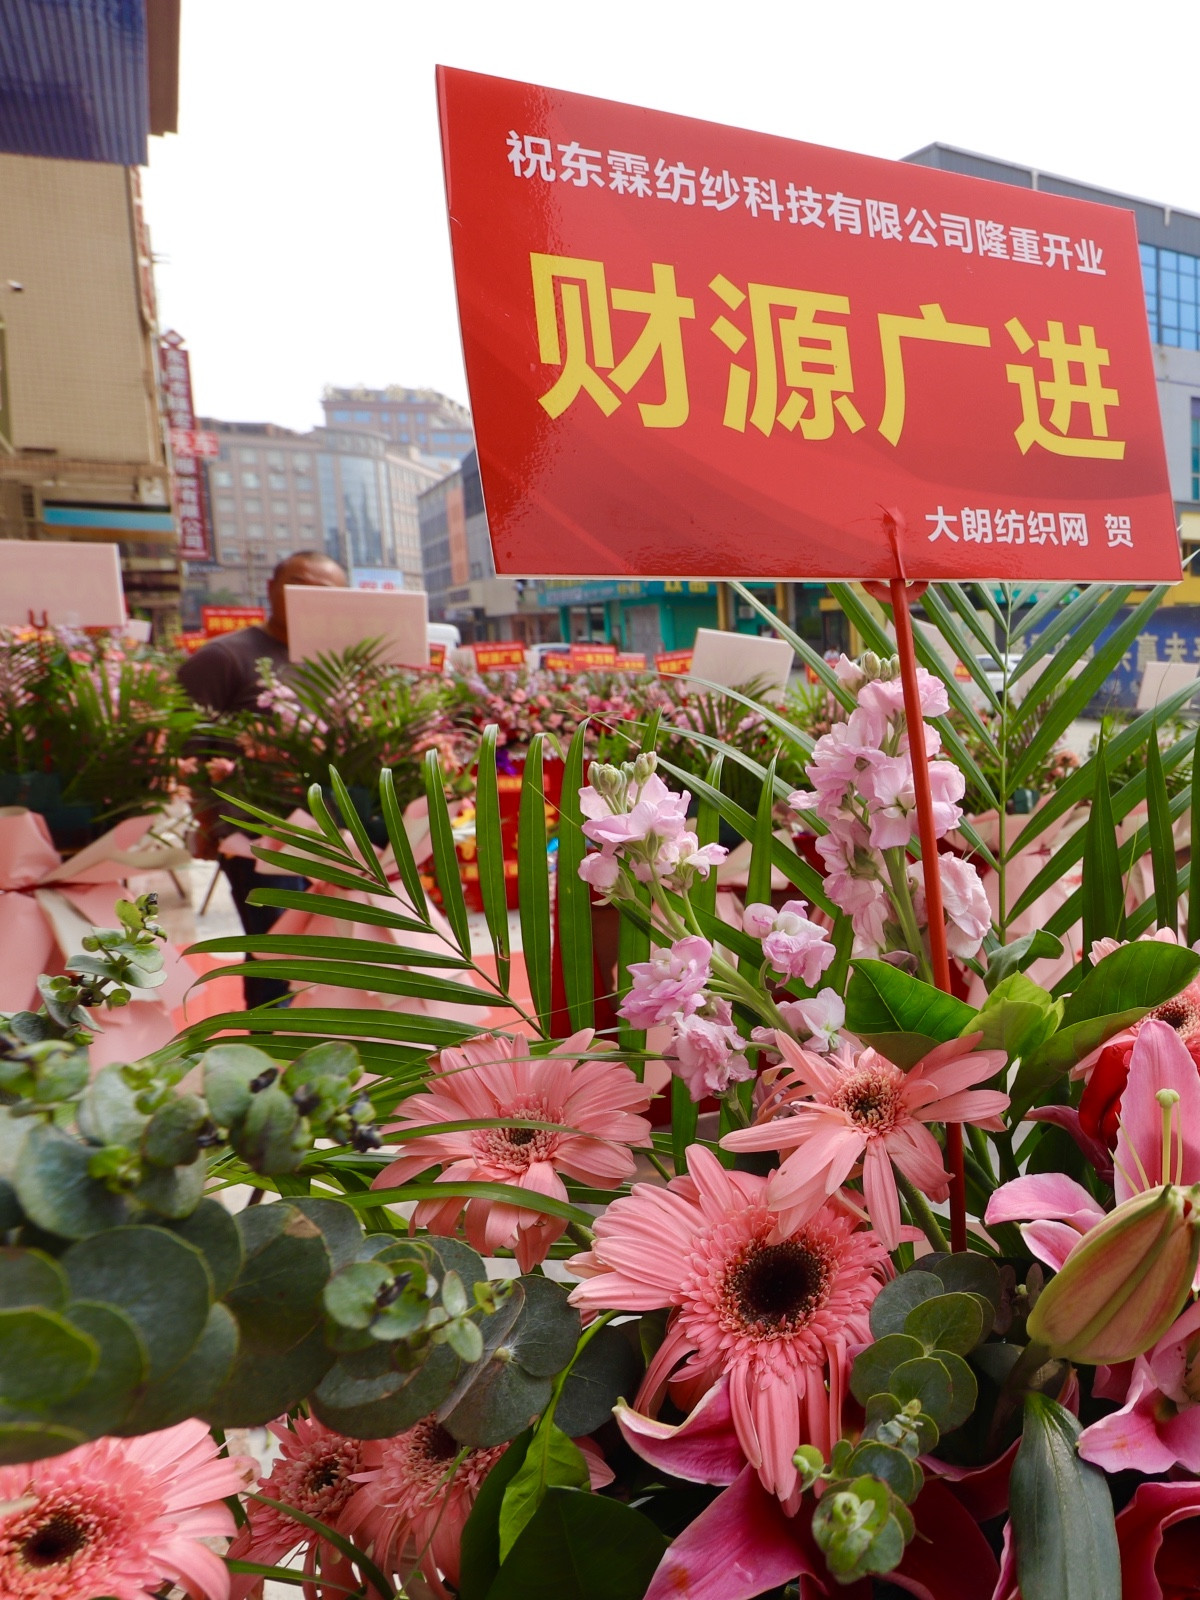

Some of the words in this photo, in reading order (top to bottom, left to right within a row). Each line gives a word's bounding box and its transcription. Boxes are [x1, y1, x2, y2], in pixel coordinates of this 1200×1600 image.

[506, 130, 1107, 277] 祝东霖纺纱科技有限公司隆重开业
[530, 252, 1126, 460] 财源广进
[925, 505, 1089, 548] 大朗纺织网
[1104, 513, 1134, 548] 贺
